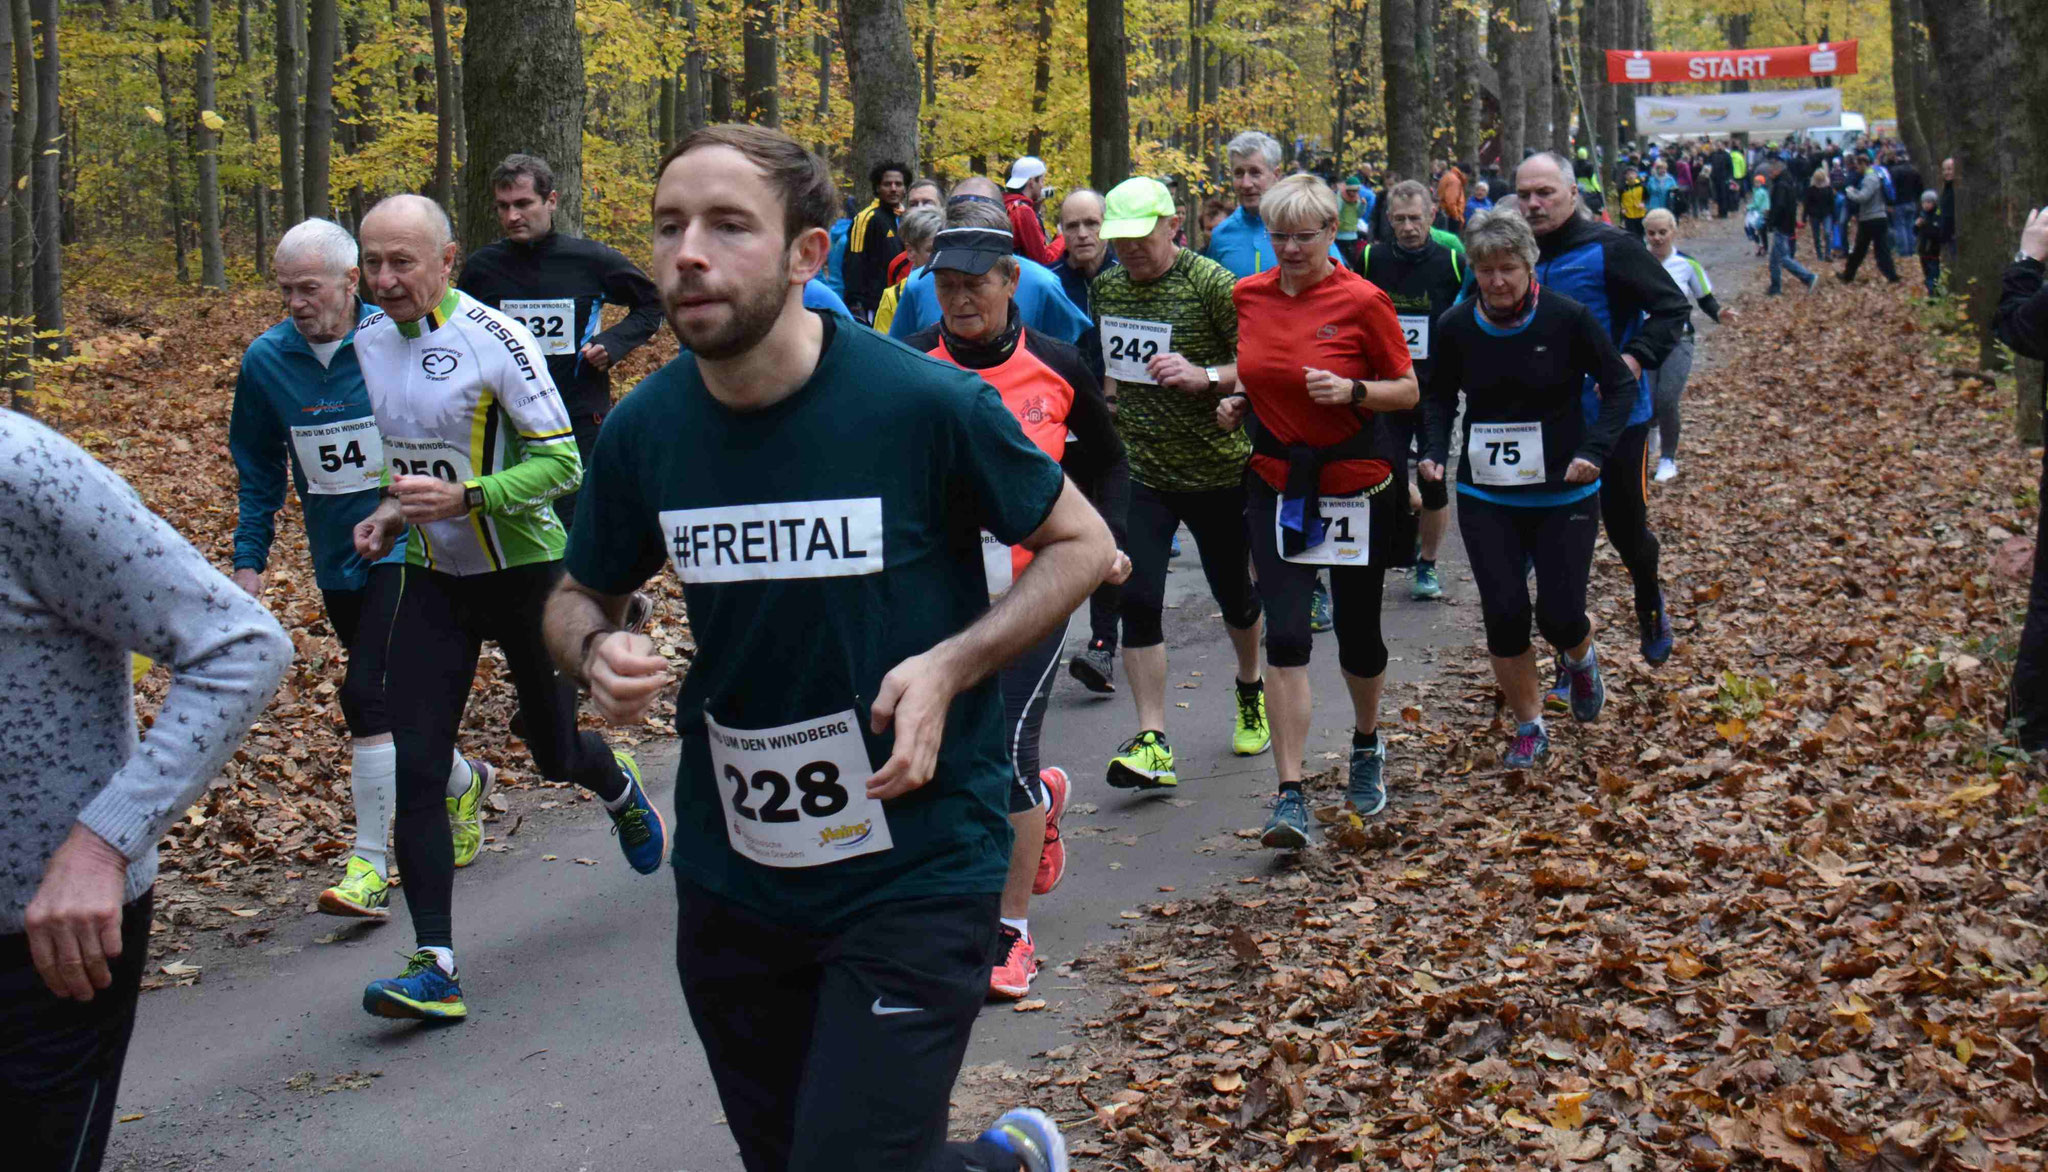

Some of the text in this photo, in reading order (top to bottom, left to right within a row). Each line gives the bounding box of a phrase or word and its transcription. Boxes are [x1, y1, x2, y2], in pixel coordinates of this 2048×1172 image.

[1688, 55, 1771, 79] START
[1140, 325, 1167, 334] WINDBERG
[1401, 329, 1419, 345] 2
[466, 306, 536, 381] Dresden
[1109, 336, 1158, 364] 242
[325, 426, 340, 436] DEN
[319, 440, 366, 473] 54
[417, 442, 451, 450] WINDBE
[1485, 441, 1520, 466] 75
[673, 516, 867, 568] #FREITAL
[1320, 516, 1355, 543] 71
[723, 721, 849, 751] UM DEN WINDBERG
[724, 760, 849, 824] 228
